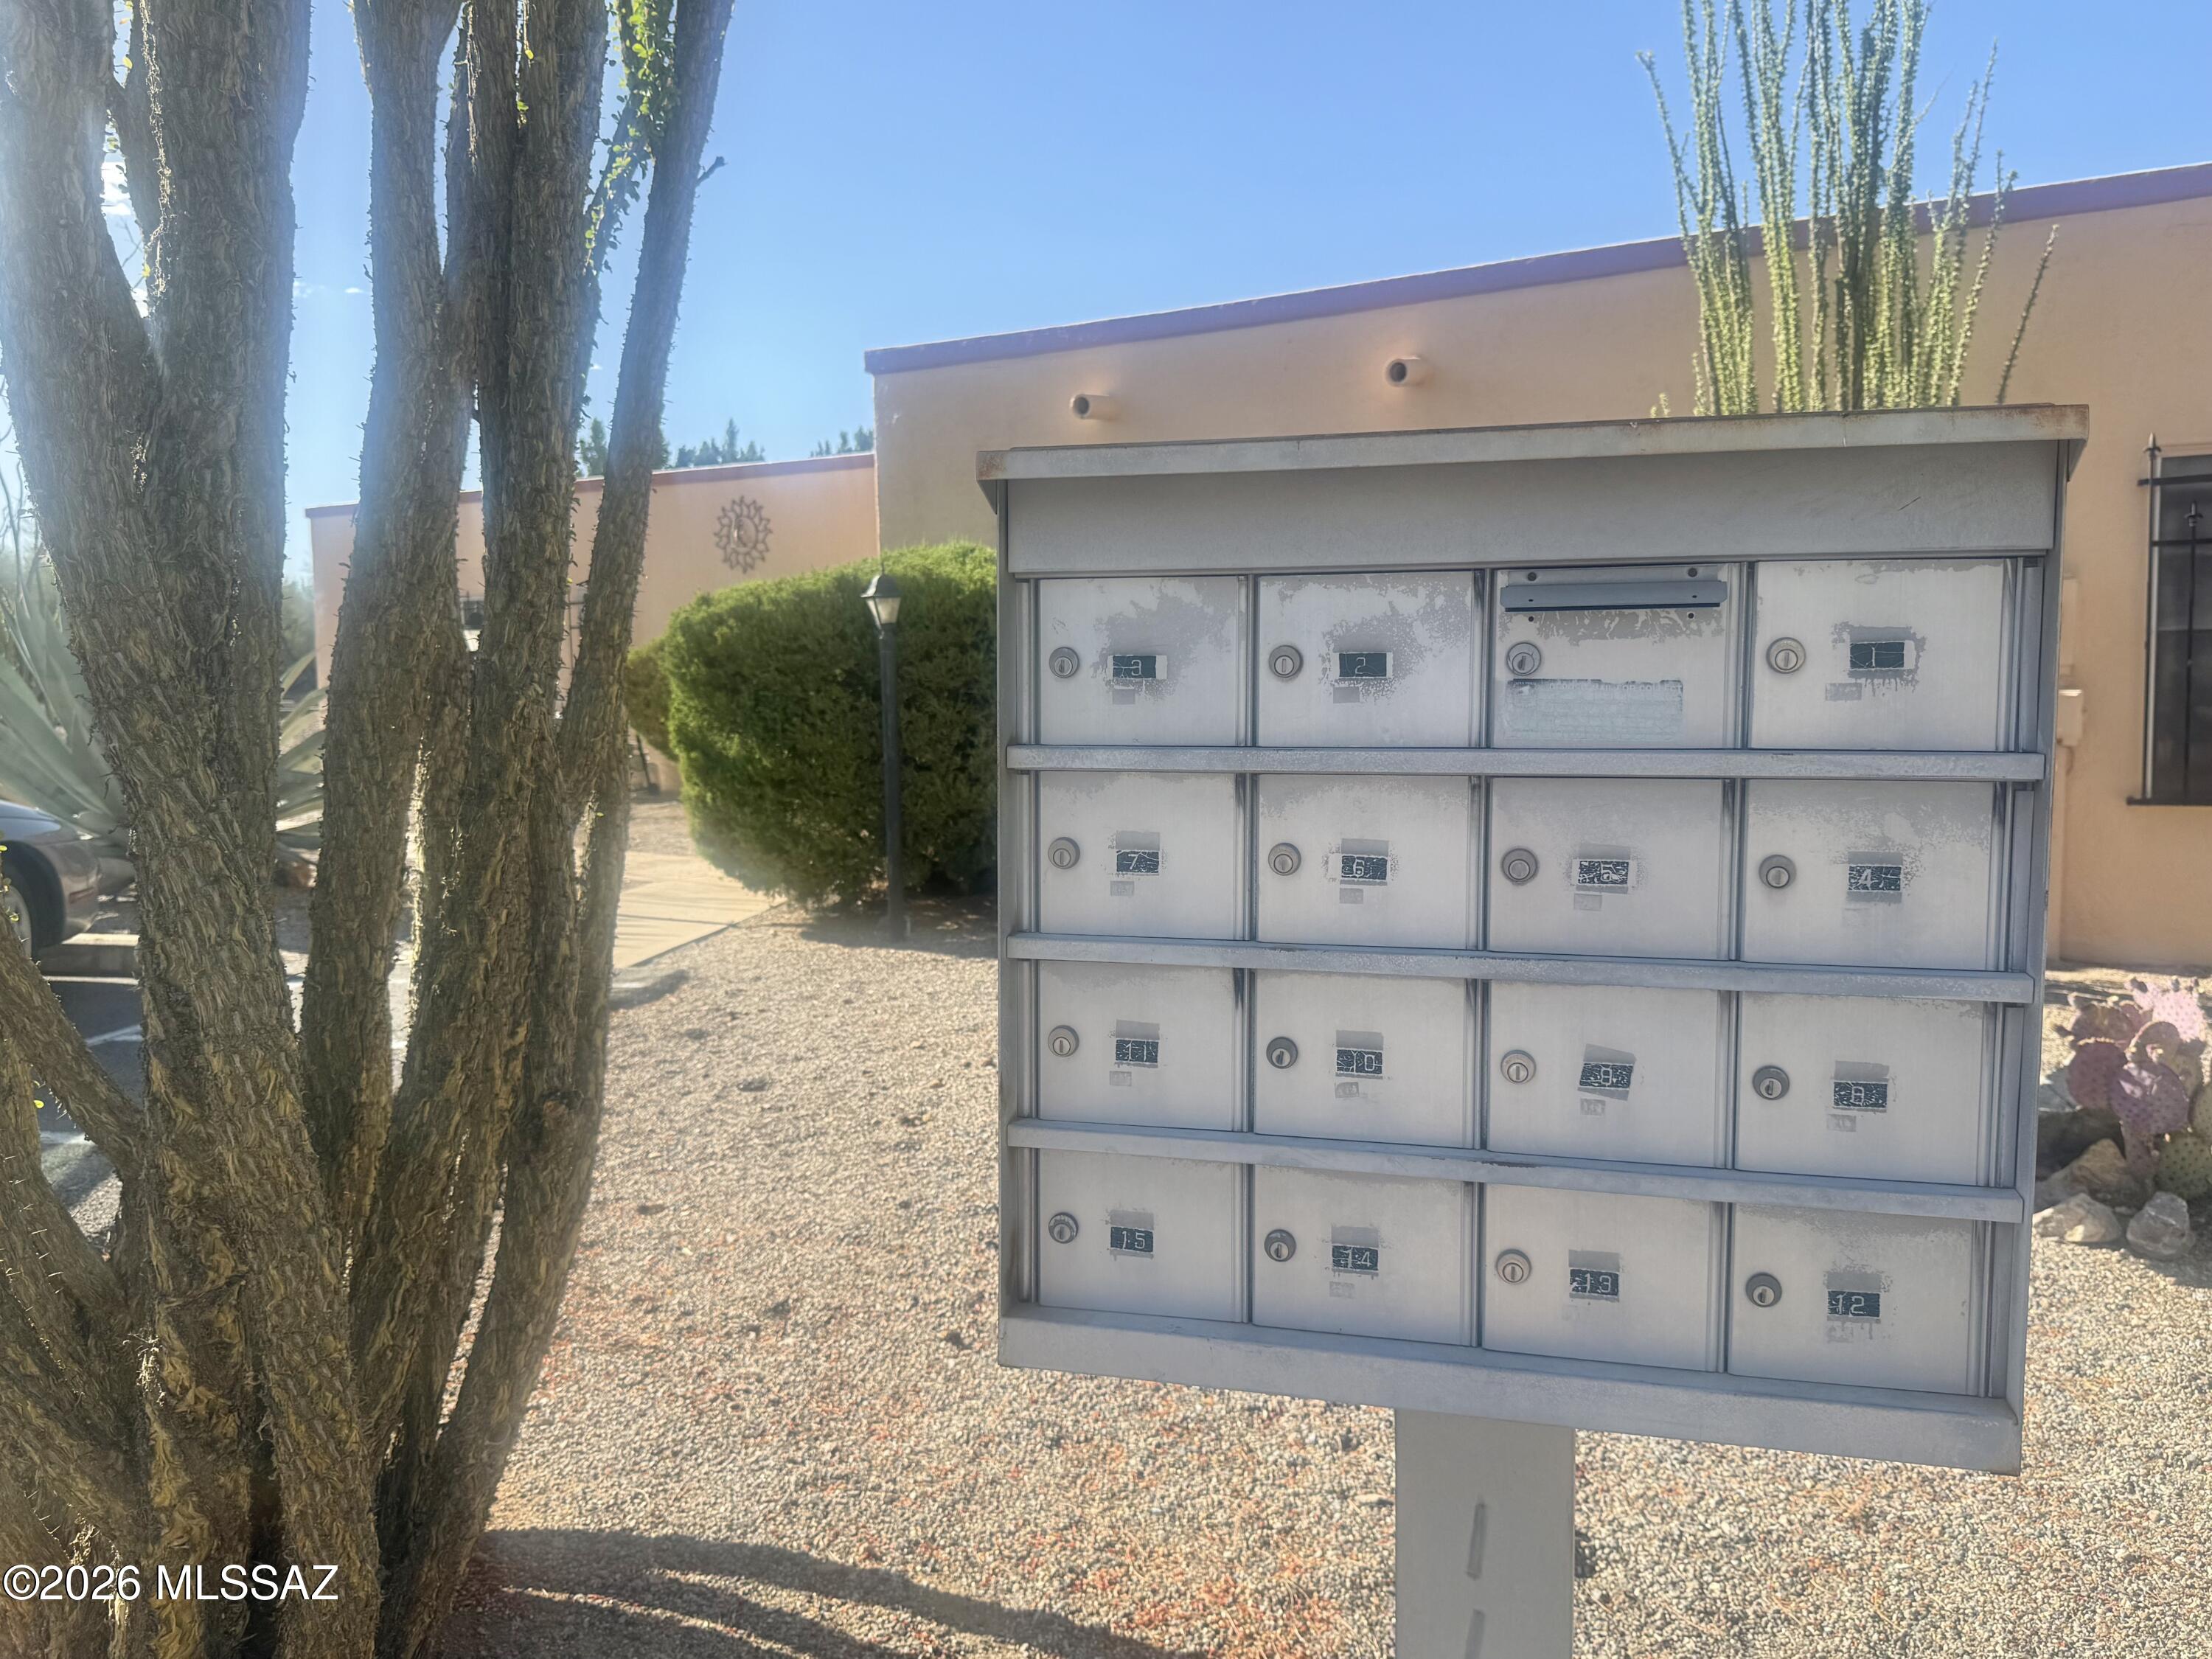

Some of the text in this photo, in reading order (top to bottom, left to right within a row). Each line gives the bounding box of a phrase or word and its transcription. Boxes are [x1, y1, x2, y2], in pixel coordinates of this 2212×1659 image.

[1131, 659, 1141, 675] 3
[1356, 657, 1366, 674] 2
[1128, 853, 1140, 870] 7
[1354, 859, 1365, 877] 6
[1122, 1231, 1145, 1250] 15
[1348, 1248, 1371, 1267] 14
[1585, 1273, 1611, 1293] 13
[1836, 1294, 1865, 1314] 12
